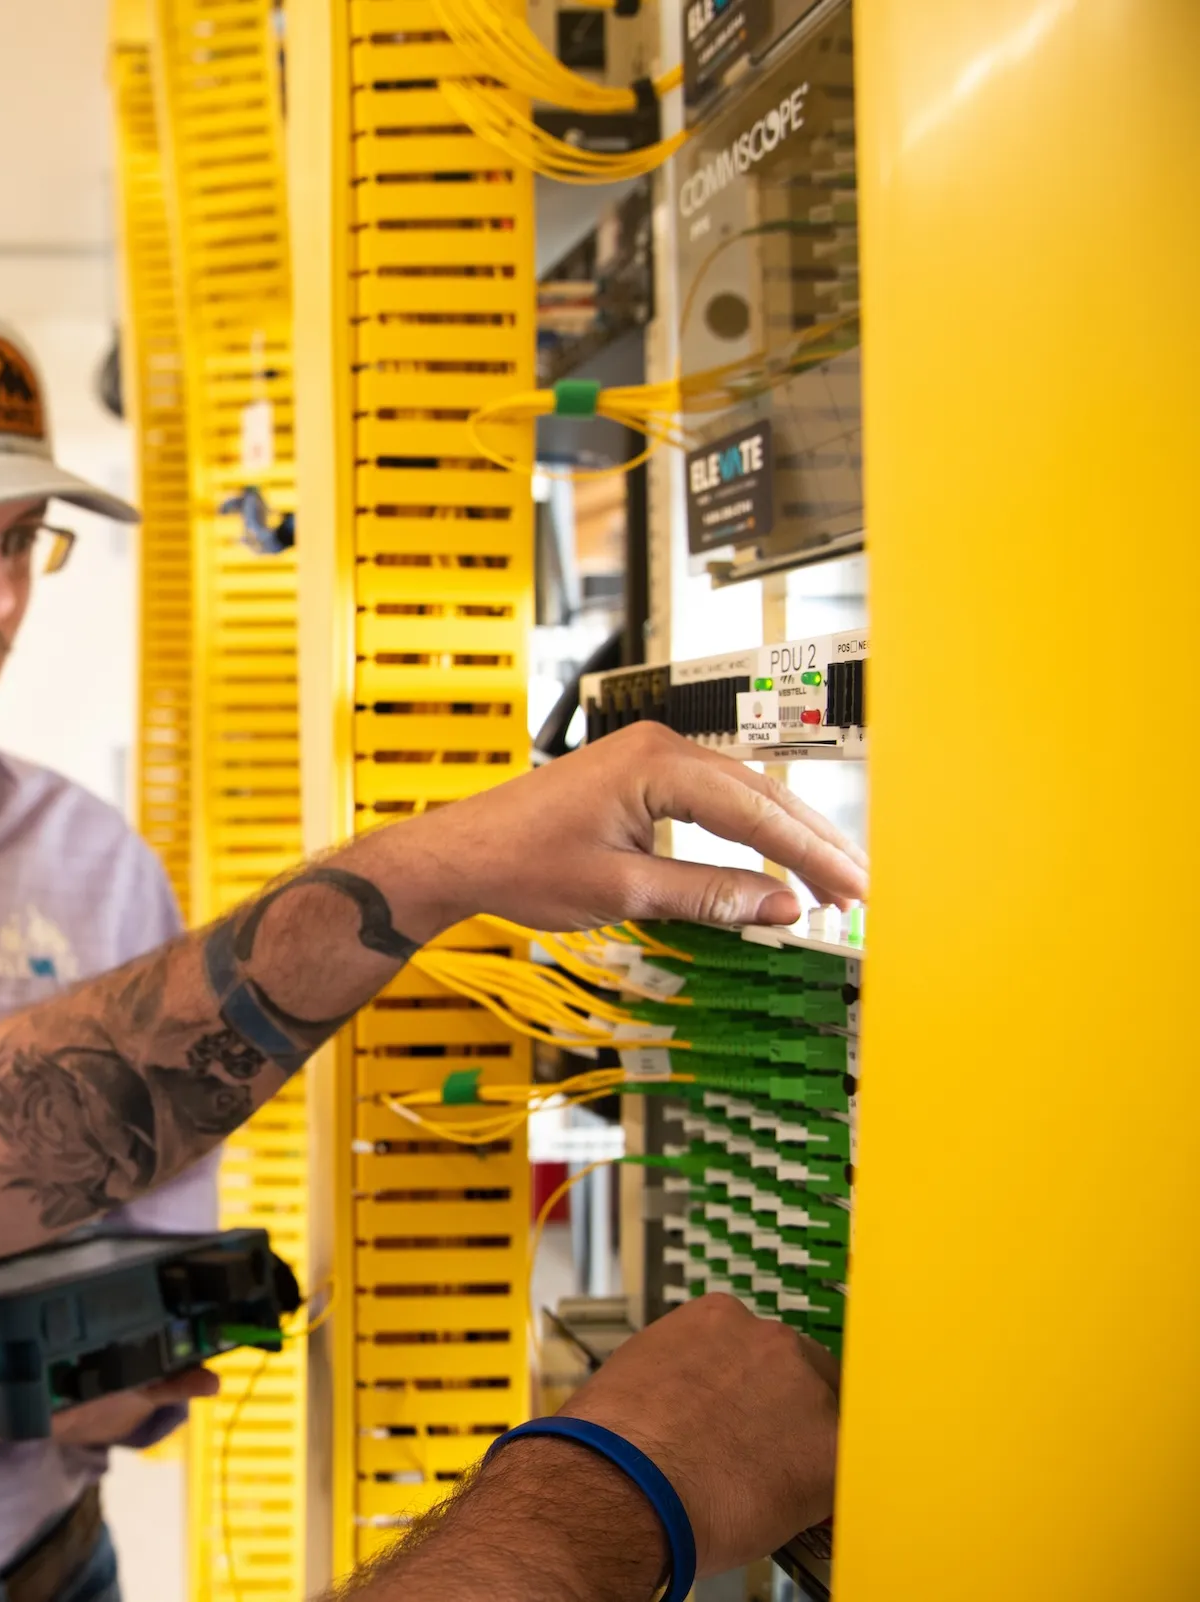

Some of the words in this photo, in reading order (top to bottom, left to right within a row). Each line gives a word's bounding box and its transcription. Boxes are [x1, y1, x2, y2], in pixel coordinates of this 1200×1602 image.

[689, 433, 763, 495] ELEVATE
[837, 643, 850, 653] POS
[770, 645, 803, 674] PDU
[807, 643, 817, 669] 2
[740, 722, 777, 730] INSTALLATION
[748, 733, 770, 741] DETAILS
